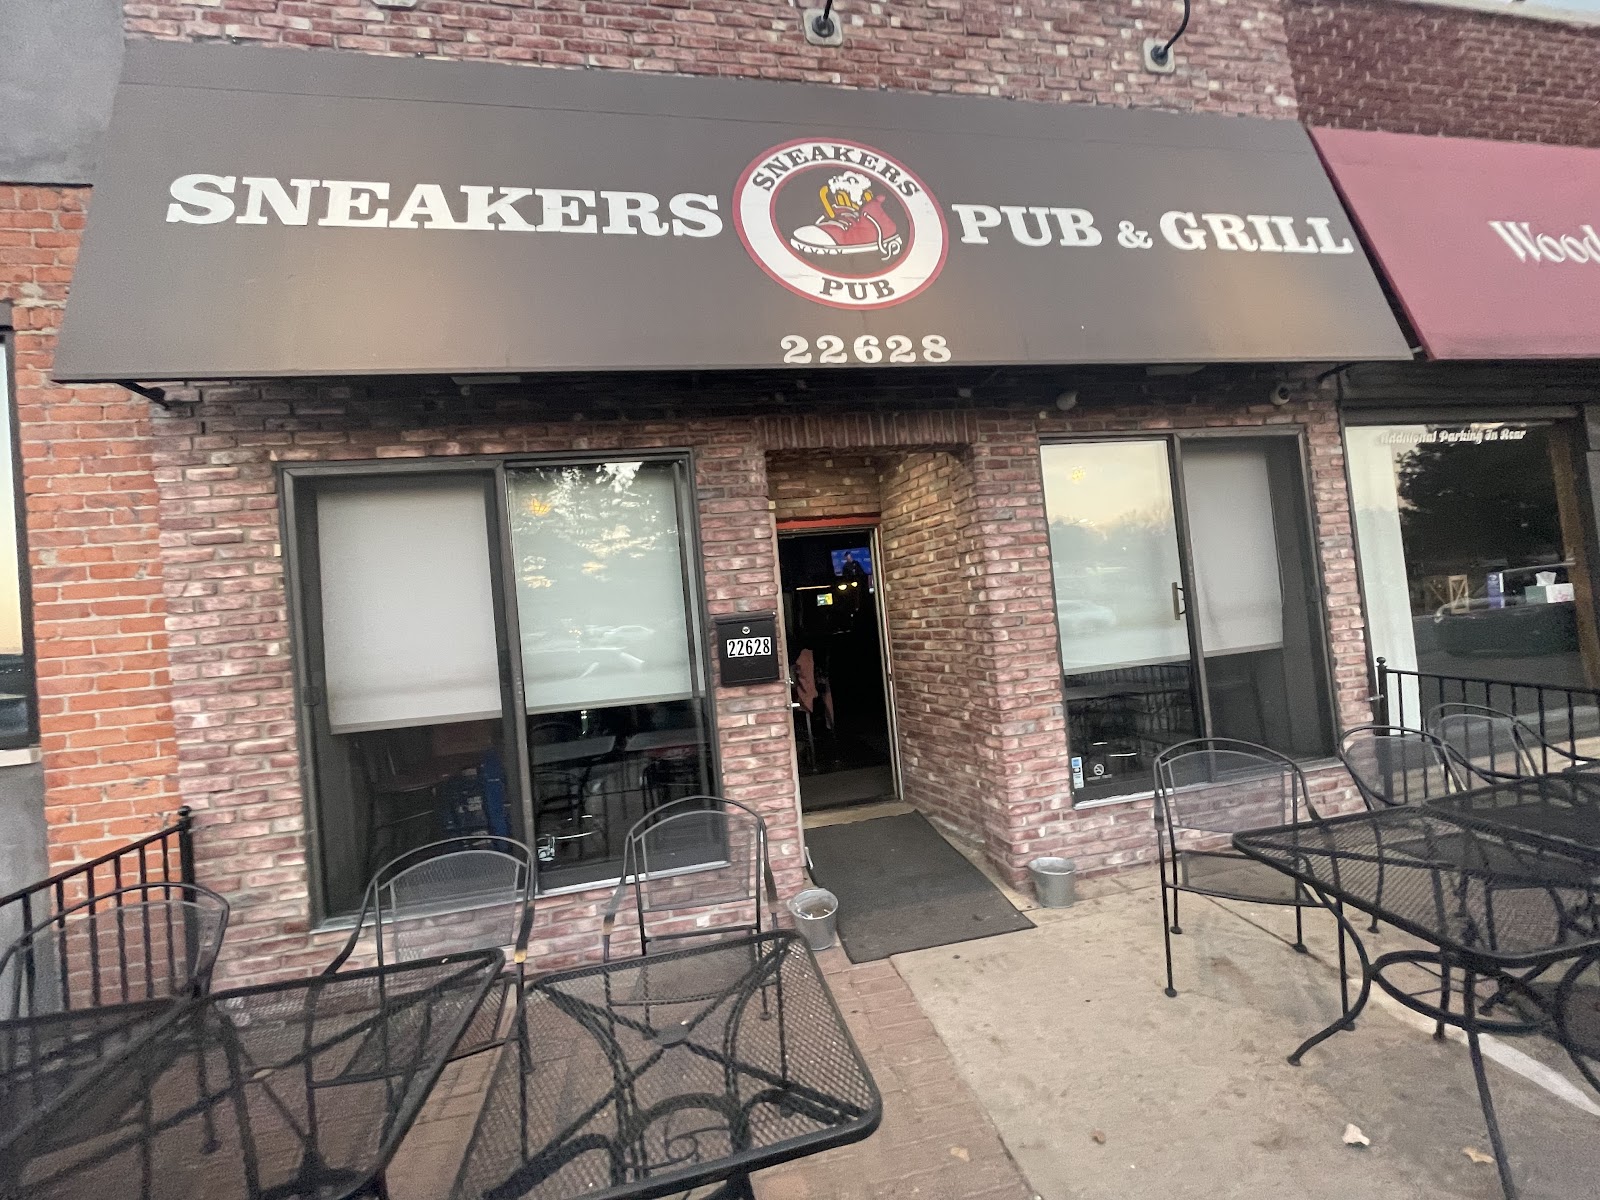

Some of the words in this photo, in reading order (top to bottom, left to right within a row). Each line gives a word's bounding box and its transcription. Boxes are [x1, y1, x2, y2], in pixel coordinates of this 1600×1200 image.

[752, 145, 920, 198] SNEAKERS
[166, 174, 723, 237] SNEAKERS
[951, 203, 1102, 247] PUB
[1117, 220, 1153, 249] &
[1159, 210, 1354, 254] GRILL
[819, 277, 895, 300] PUB
[780, 334, 952, 364] 22628
[1439, 429, 1483, 444] Parking
[1485, 429, 1498, 441] In
[1500, 428, 1526, 440] Rear
[728, 638, 770, 657] 22628
